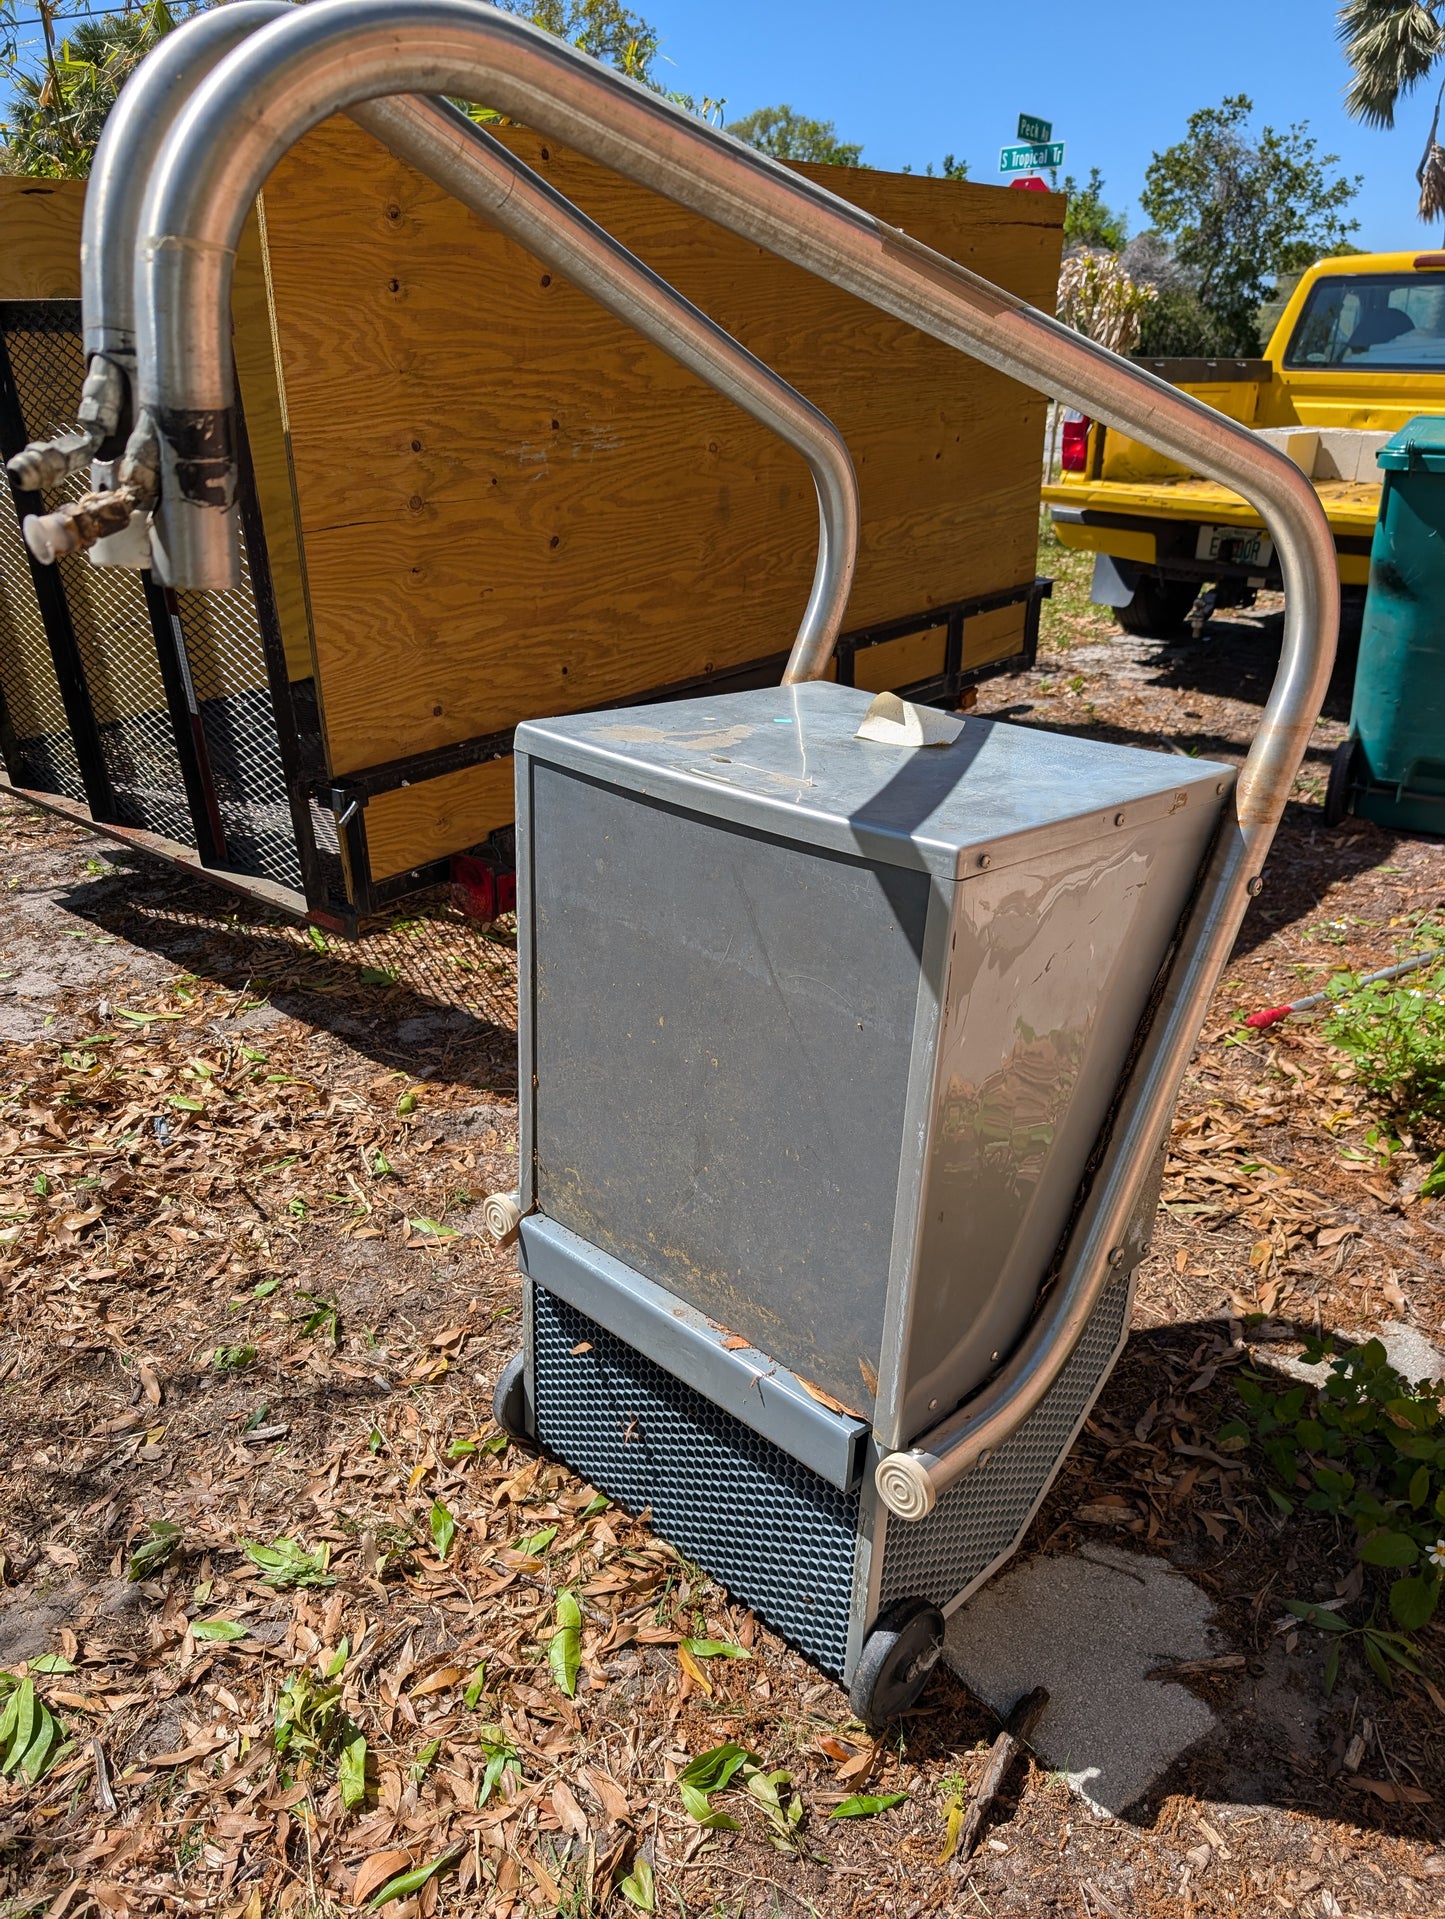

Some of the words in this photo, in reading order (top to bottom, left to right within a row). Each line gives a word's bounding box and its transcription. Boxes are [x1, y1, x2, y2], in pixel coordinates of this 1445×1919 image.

[1020, 118, 1040, 138] Peck
[1001, 152, 1008, 168] S
[1012, 149, 1048, 168] Tropical
[1053, 147, 1062, 163] Tr
